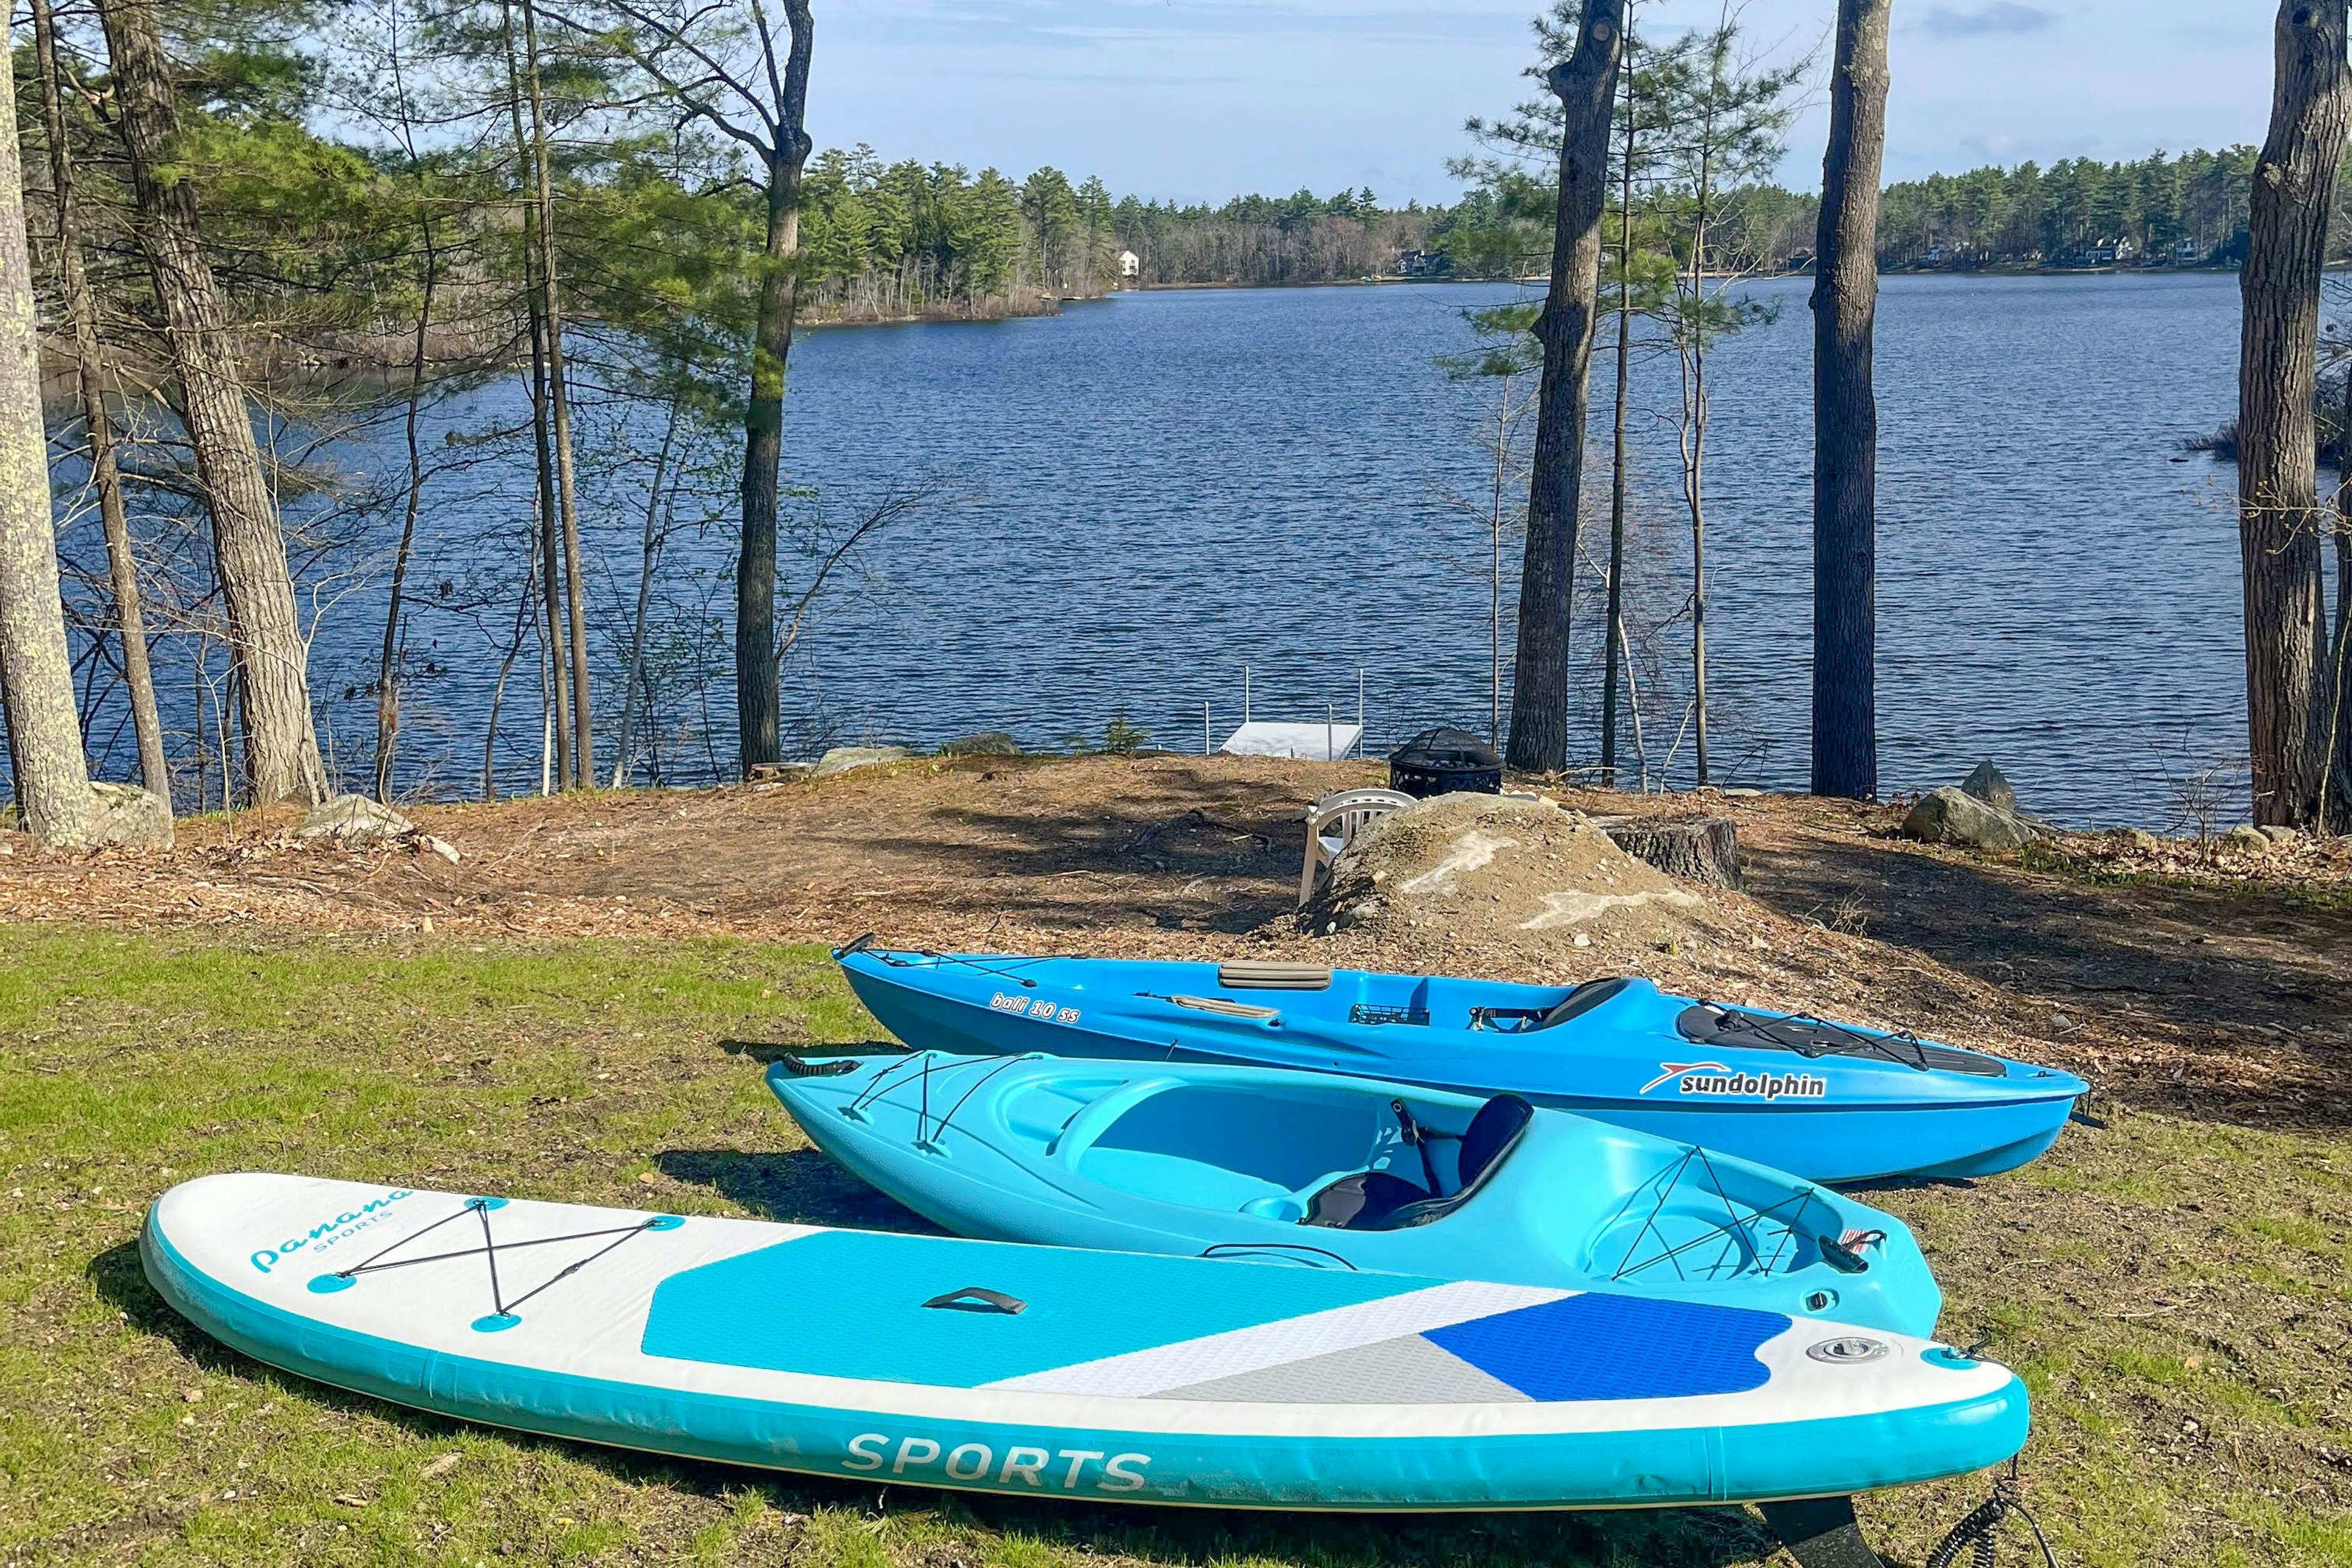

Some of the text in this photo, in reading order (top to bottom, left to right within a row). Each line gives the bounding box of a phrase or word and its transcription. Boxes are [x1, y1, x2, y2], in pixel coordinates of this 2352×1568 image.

[991, 993, 1028, 1012] bali
[1030, 1001, 1055, 1018] 10
[1681, 1073, 1824, 1099] sundolphin
[251, 1190, 414, 1273] panana
[314, 1210, 393, 1253] SPORTS
[841, 1432, 1152, 1491] SPORTS
